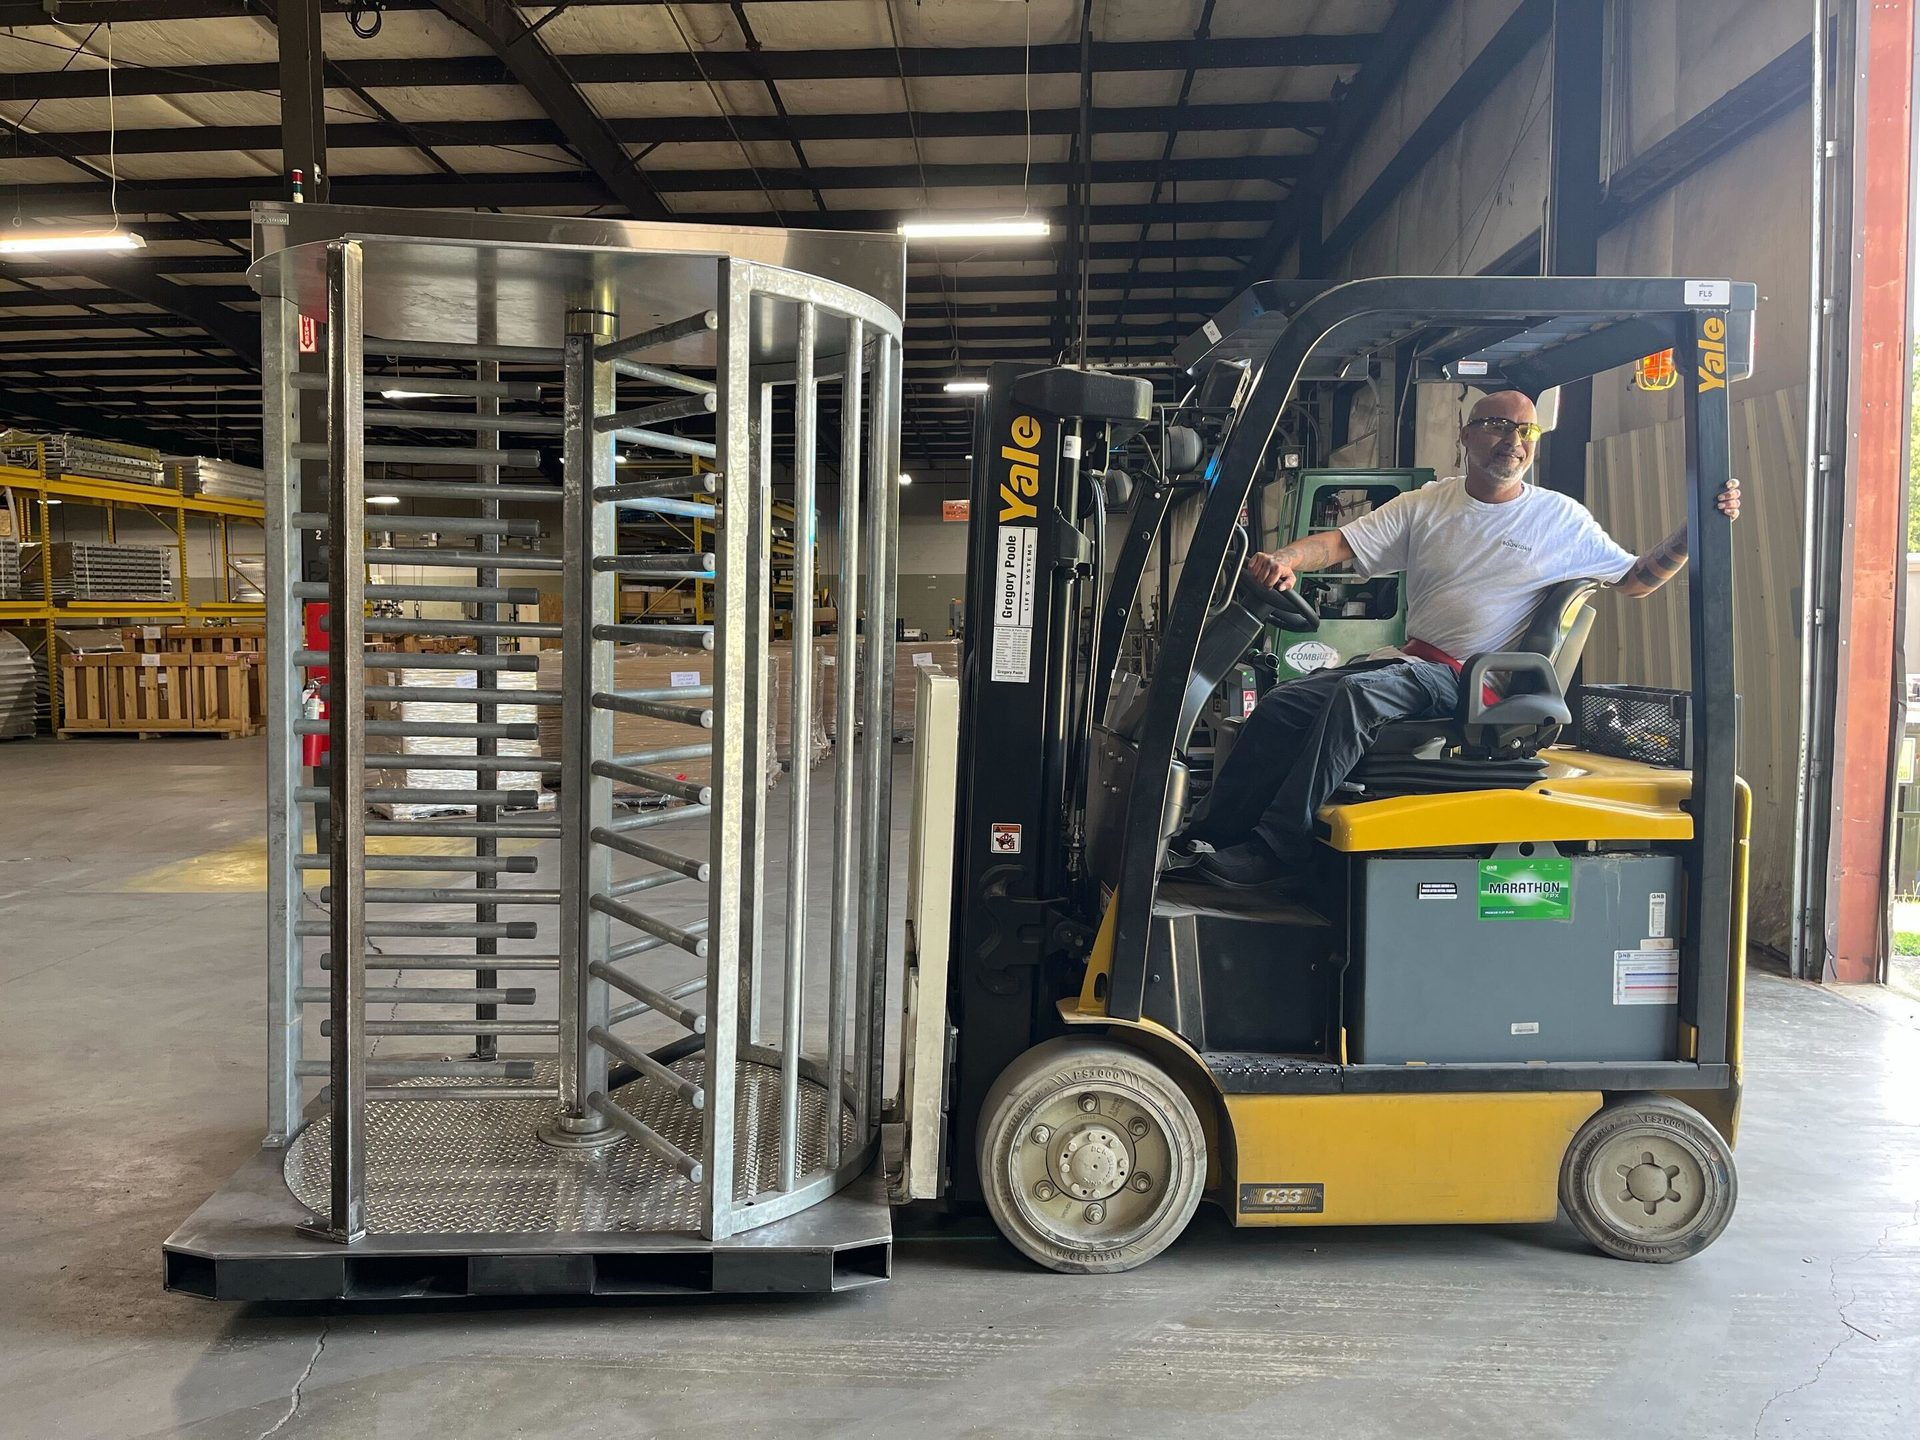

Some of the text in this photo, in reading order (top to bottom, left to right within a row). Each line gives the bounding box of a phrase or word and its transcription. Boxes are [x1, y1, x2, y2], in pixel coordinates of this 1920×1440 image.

[1698, 290, 1713, 298] FL5
[1697, 317, 1726, 393] Yale
[999, 415, 1042, 523] Yale
[315, 529, 322, 540] 2
[1025, 544, 1033, 585] SYSTEMS
[1002, 535, 1017, 619] Gregory Poole
[1489, 882, 1560, 894] MARATHON
[1645, 1114, 1682, 1129] PS1000
[1263, 1189, 1303, 1204] CSS
